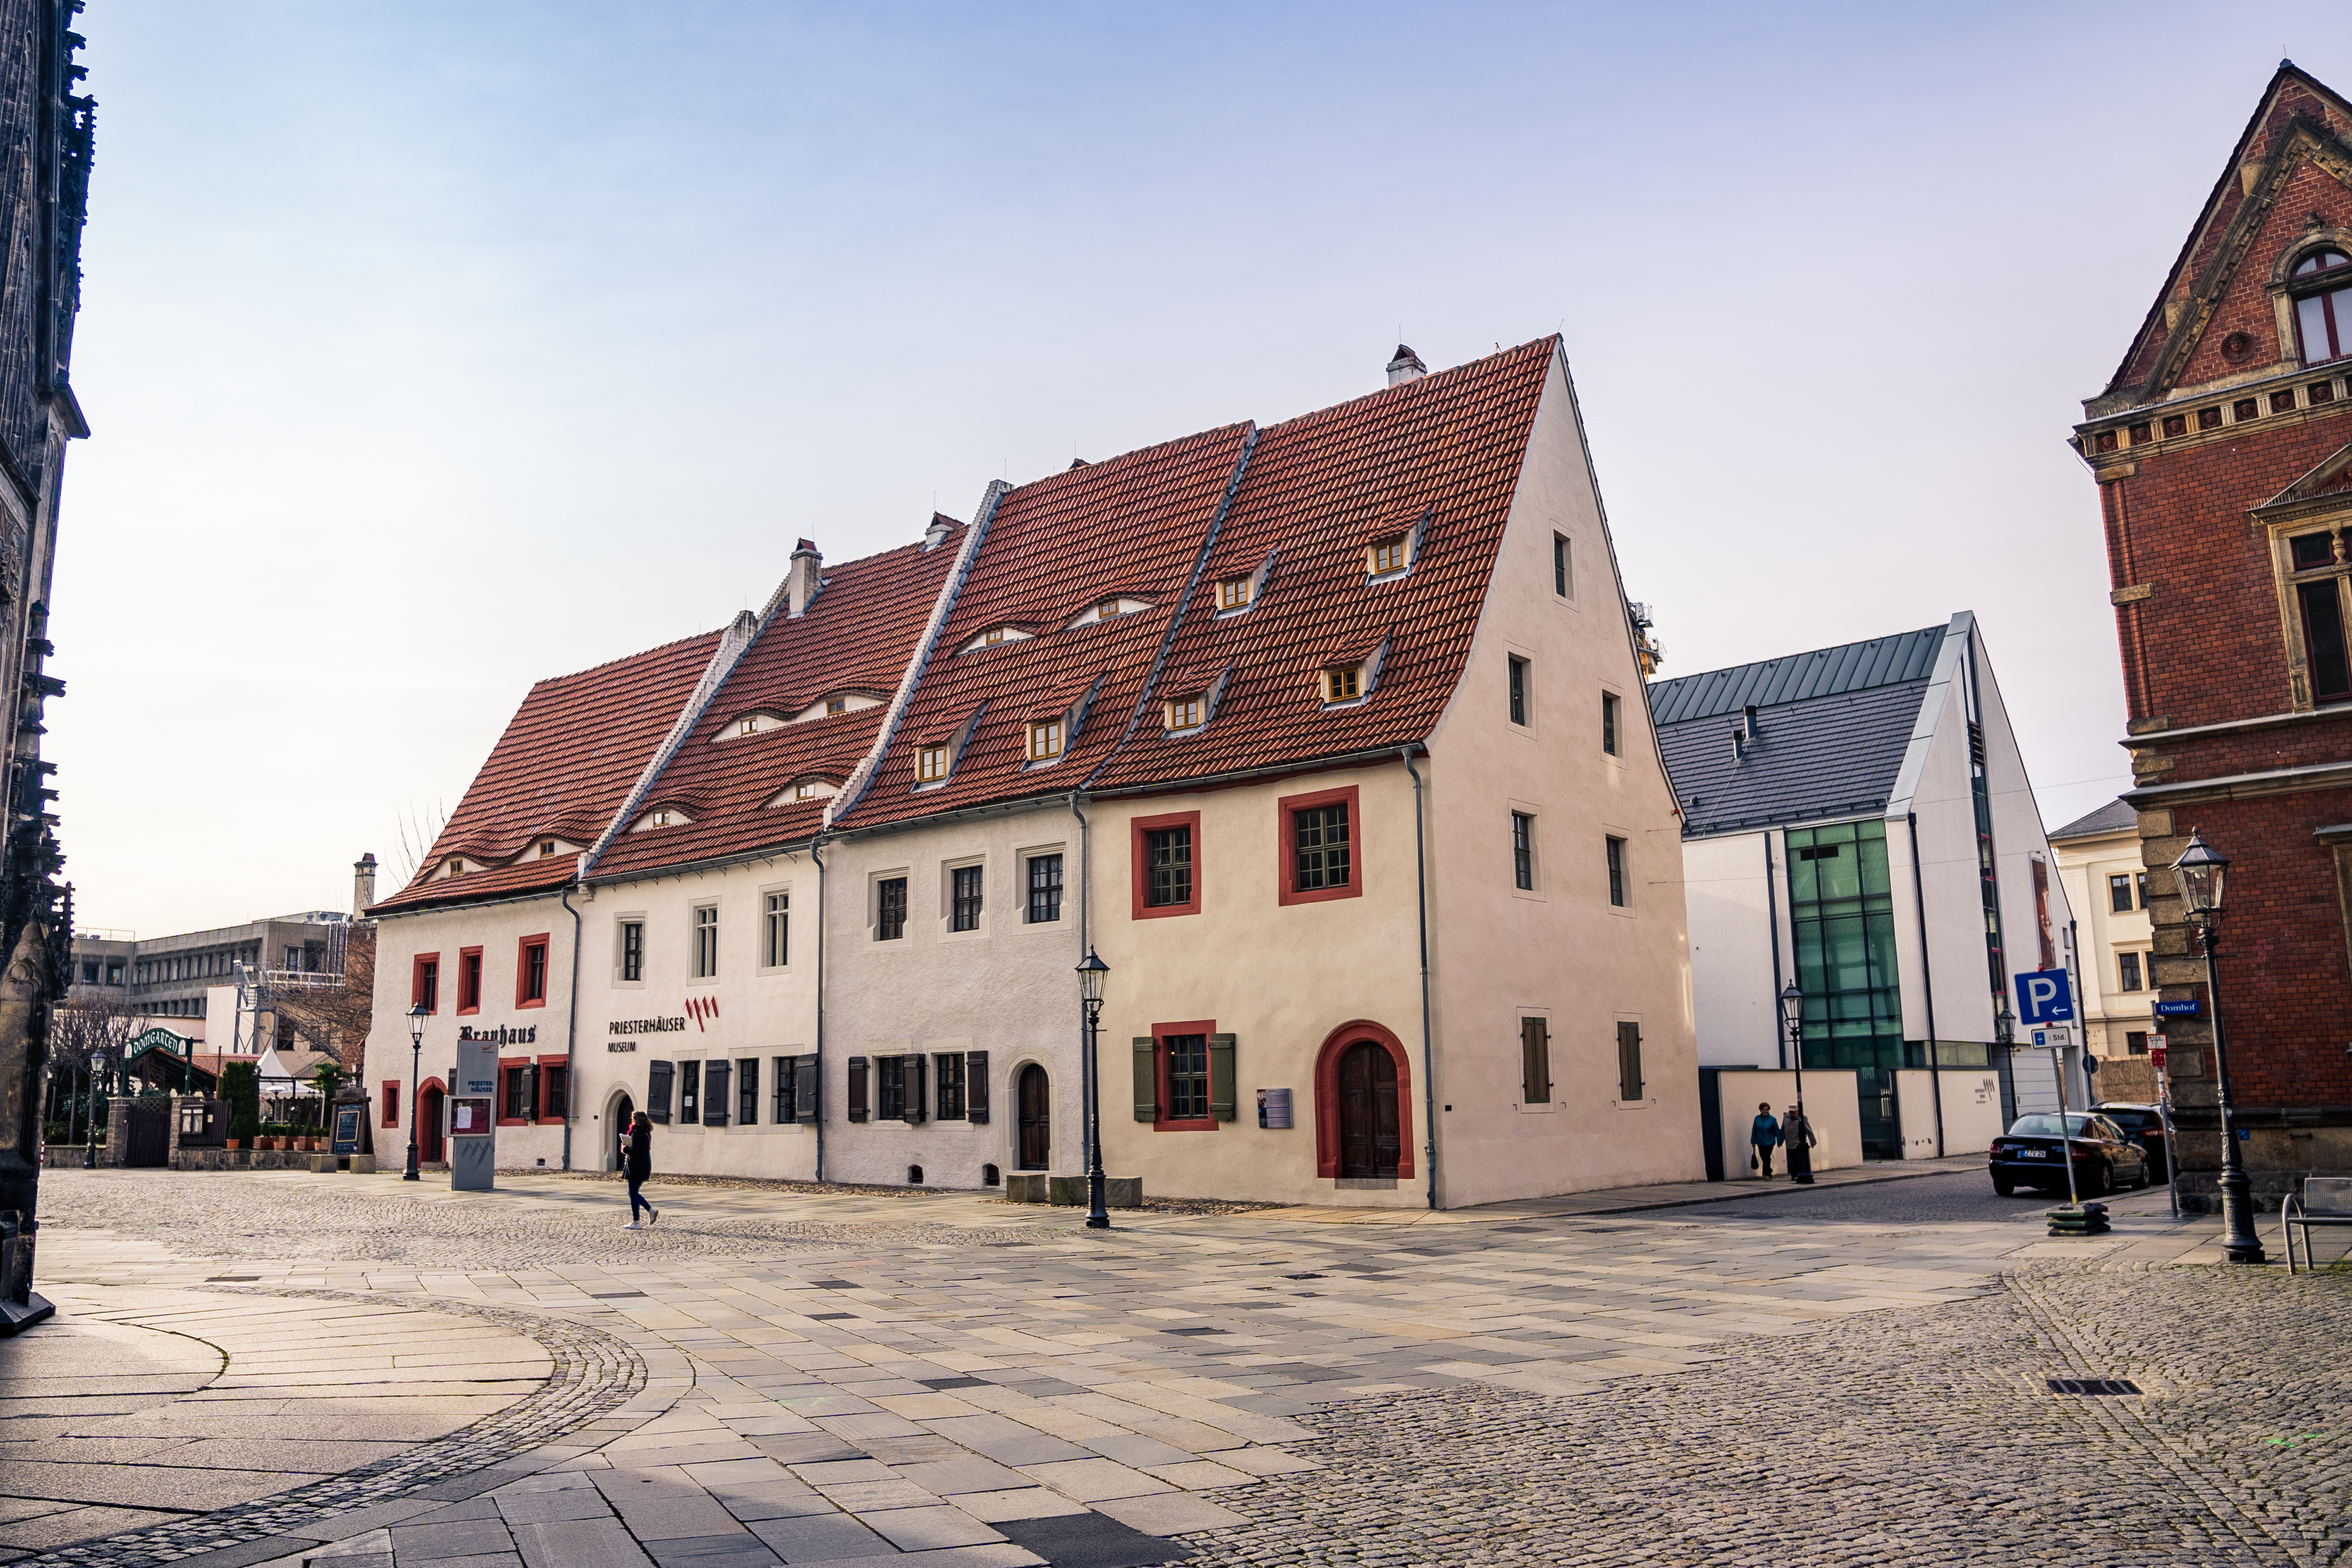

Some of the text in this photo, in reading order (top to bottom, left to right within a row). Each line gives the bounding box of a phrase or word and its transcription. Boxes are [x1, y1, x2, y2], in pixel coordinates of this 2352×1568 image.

[2028, 978, 2057, 1017] P
[2161, 1003, 2195, 1012] Domhof
[609, 1016, 685, 1035] PRIESTERHÄUSER
[134, 1031, 177, 1054] DOMGARTEN
[607, 1042, 636, 1052] MUSEUM
